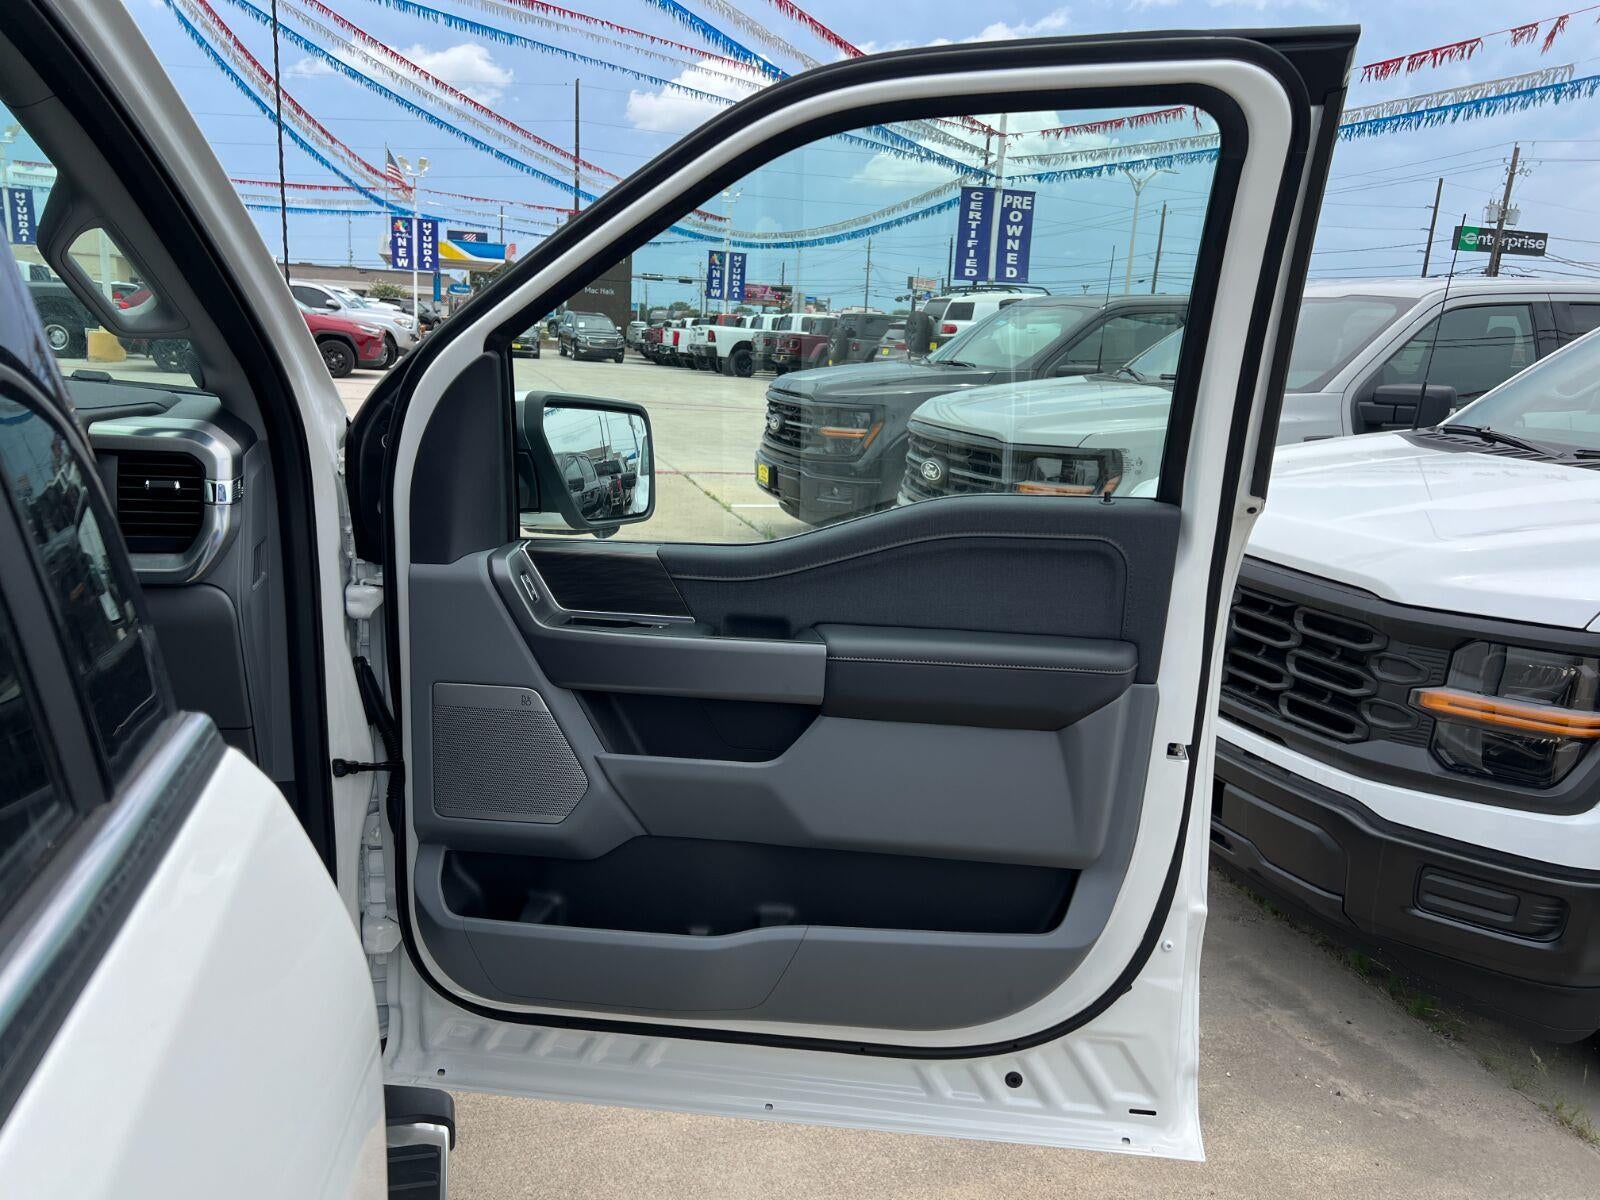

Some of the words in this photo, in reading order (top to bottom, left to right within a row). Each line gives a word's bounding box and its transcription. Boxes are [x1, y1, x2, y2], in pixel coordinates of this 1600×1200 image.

[14, 191, 31, 242] HYUNDAI
[1003, 195, 1032, 210] PRE
[396, 237, 409, 267] NEW
[422, 222, 432, 269] HYUNDAI
[964, 191, 984, 277] CERTIFIED
[1005, 211, 1024, 278] OWNED
[1461, 231, 1546, 250] entrprise
[710, 269, 721, 298] NEW
[732, 255, 742, 298] HYUNDAI
